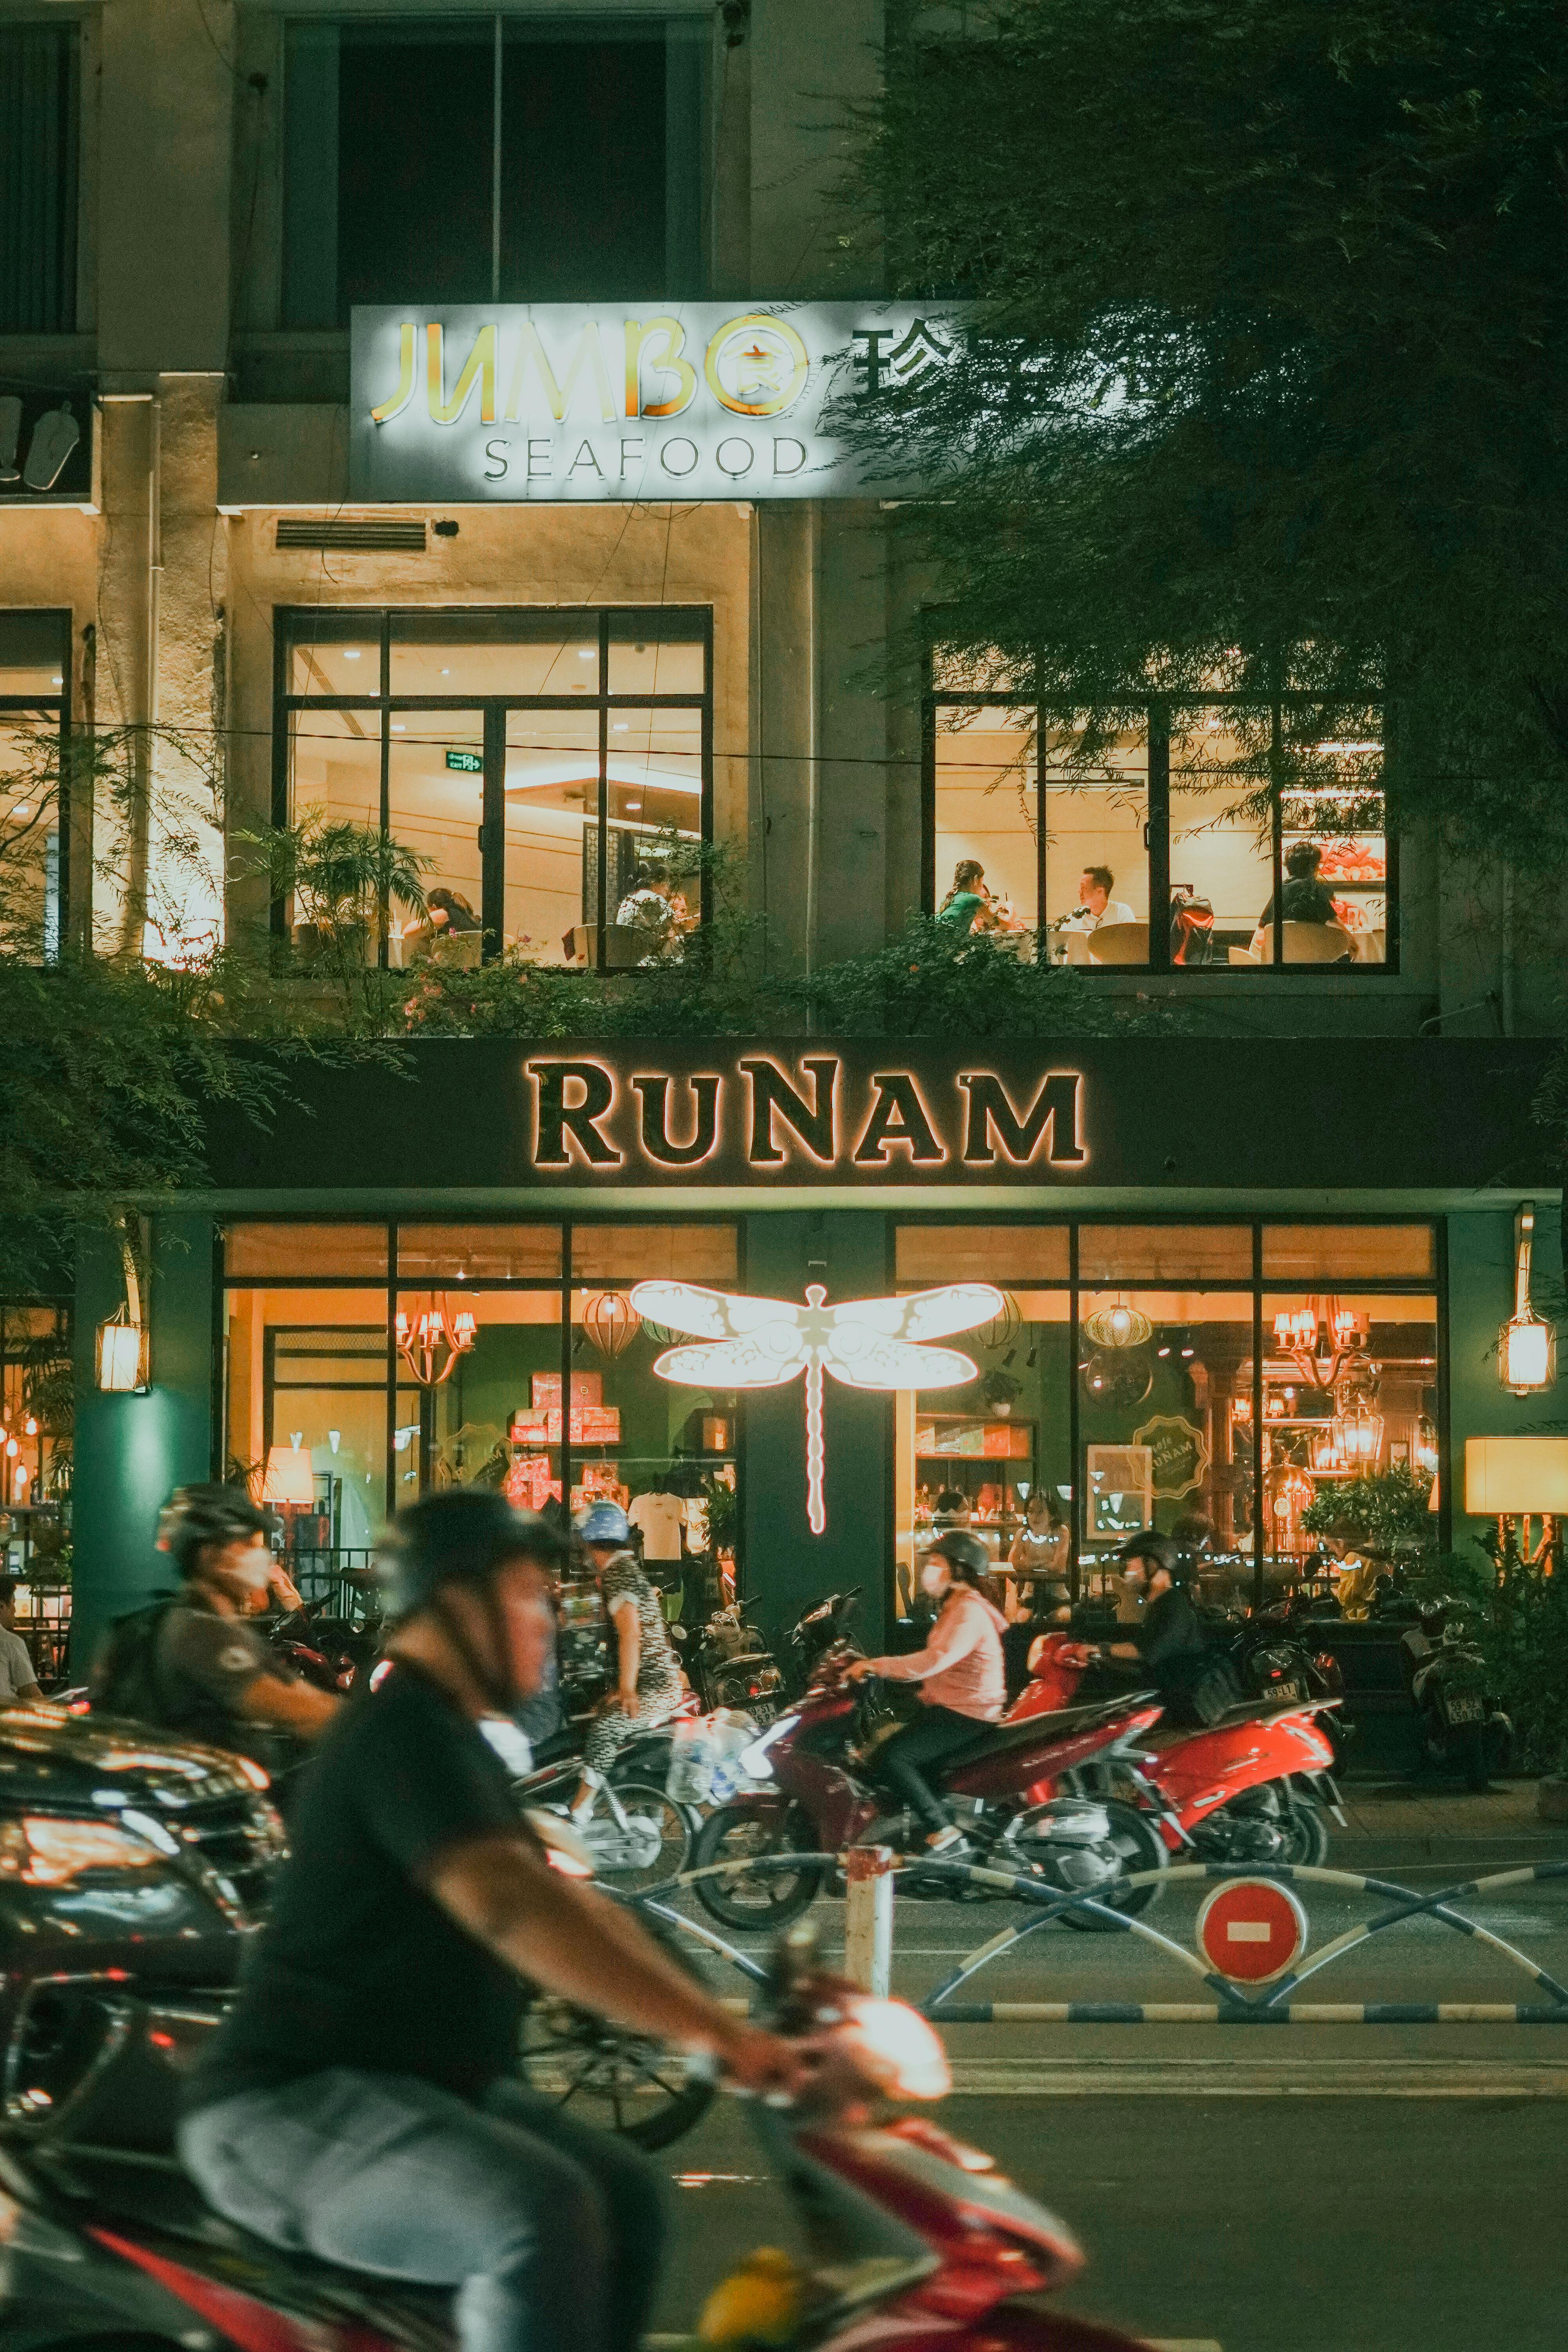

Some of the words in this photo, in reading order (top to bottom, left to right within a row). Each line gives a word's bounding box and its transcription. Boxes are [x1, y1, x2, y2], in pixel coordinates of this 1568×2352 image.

[371, 315, 809, 423] JUMBO
[484, 437, 806, 478] SEAFOOD
[528, 1059, 1085, 1165] RUNAM
[1152, 1441, 1193, 1470] UNAM
